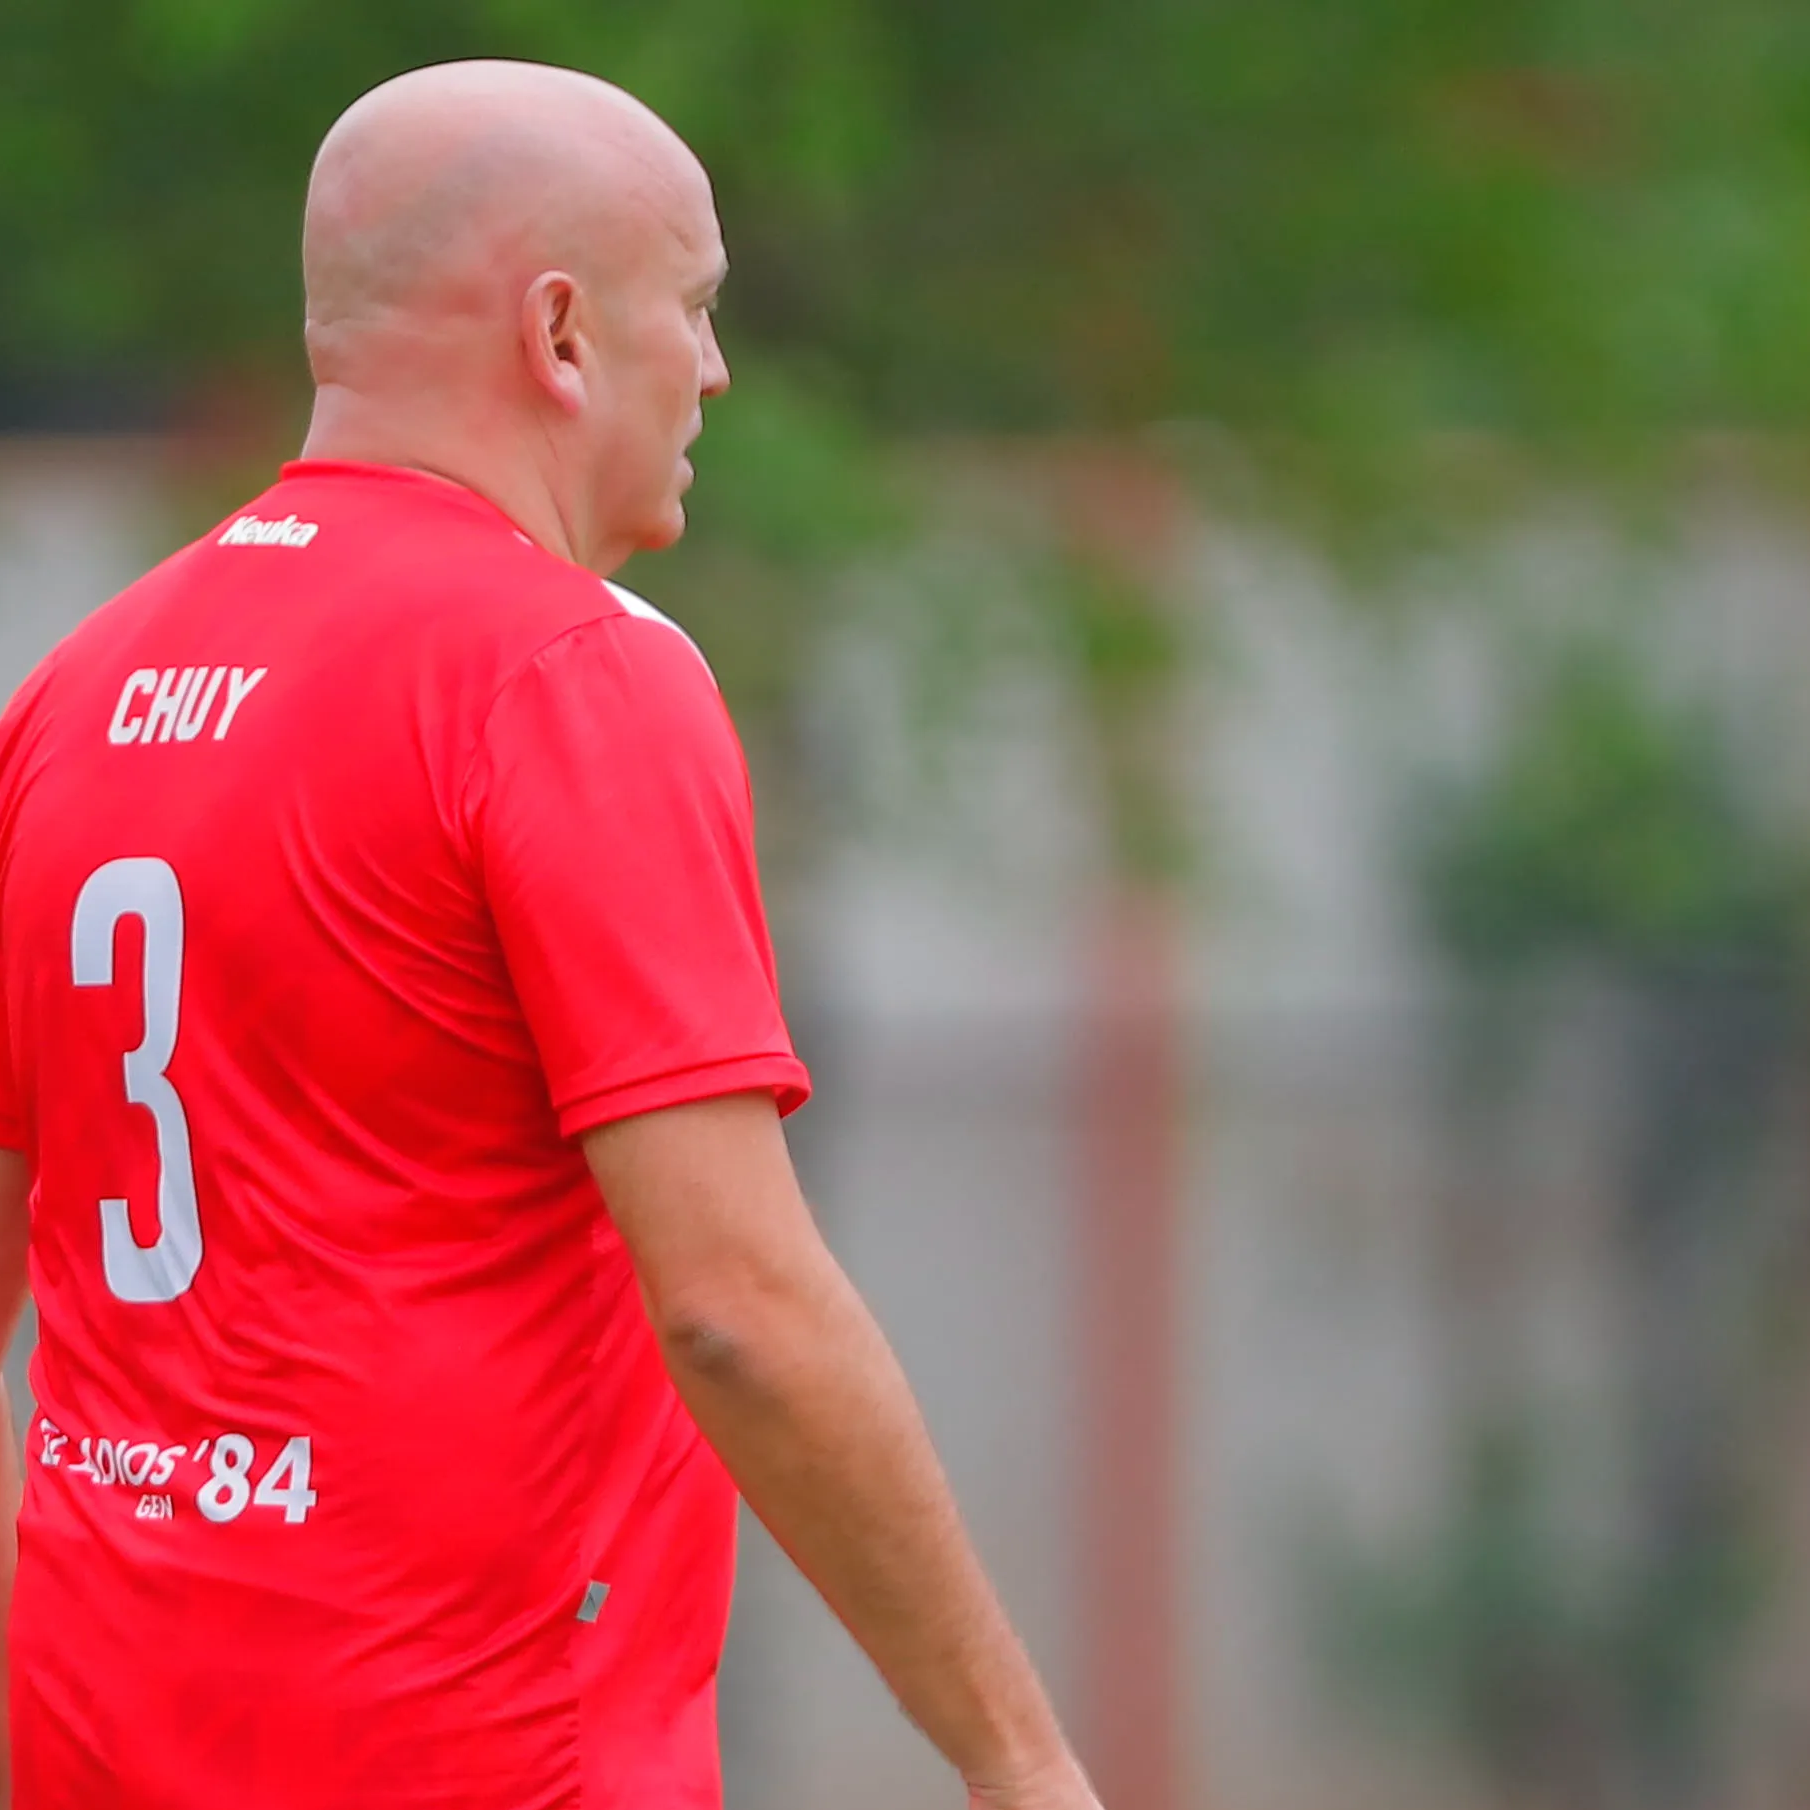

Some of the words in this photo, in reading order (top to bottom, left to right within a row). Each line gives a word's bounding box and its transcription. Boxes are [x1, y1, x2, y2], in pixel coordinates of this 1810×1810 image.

[107, 666, 268, 745] CHUY
[71, 856, 204, 1303] 3
[135, 1494, 174, 1520] GEN
